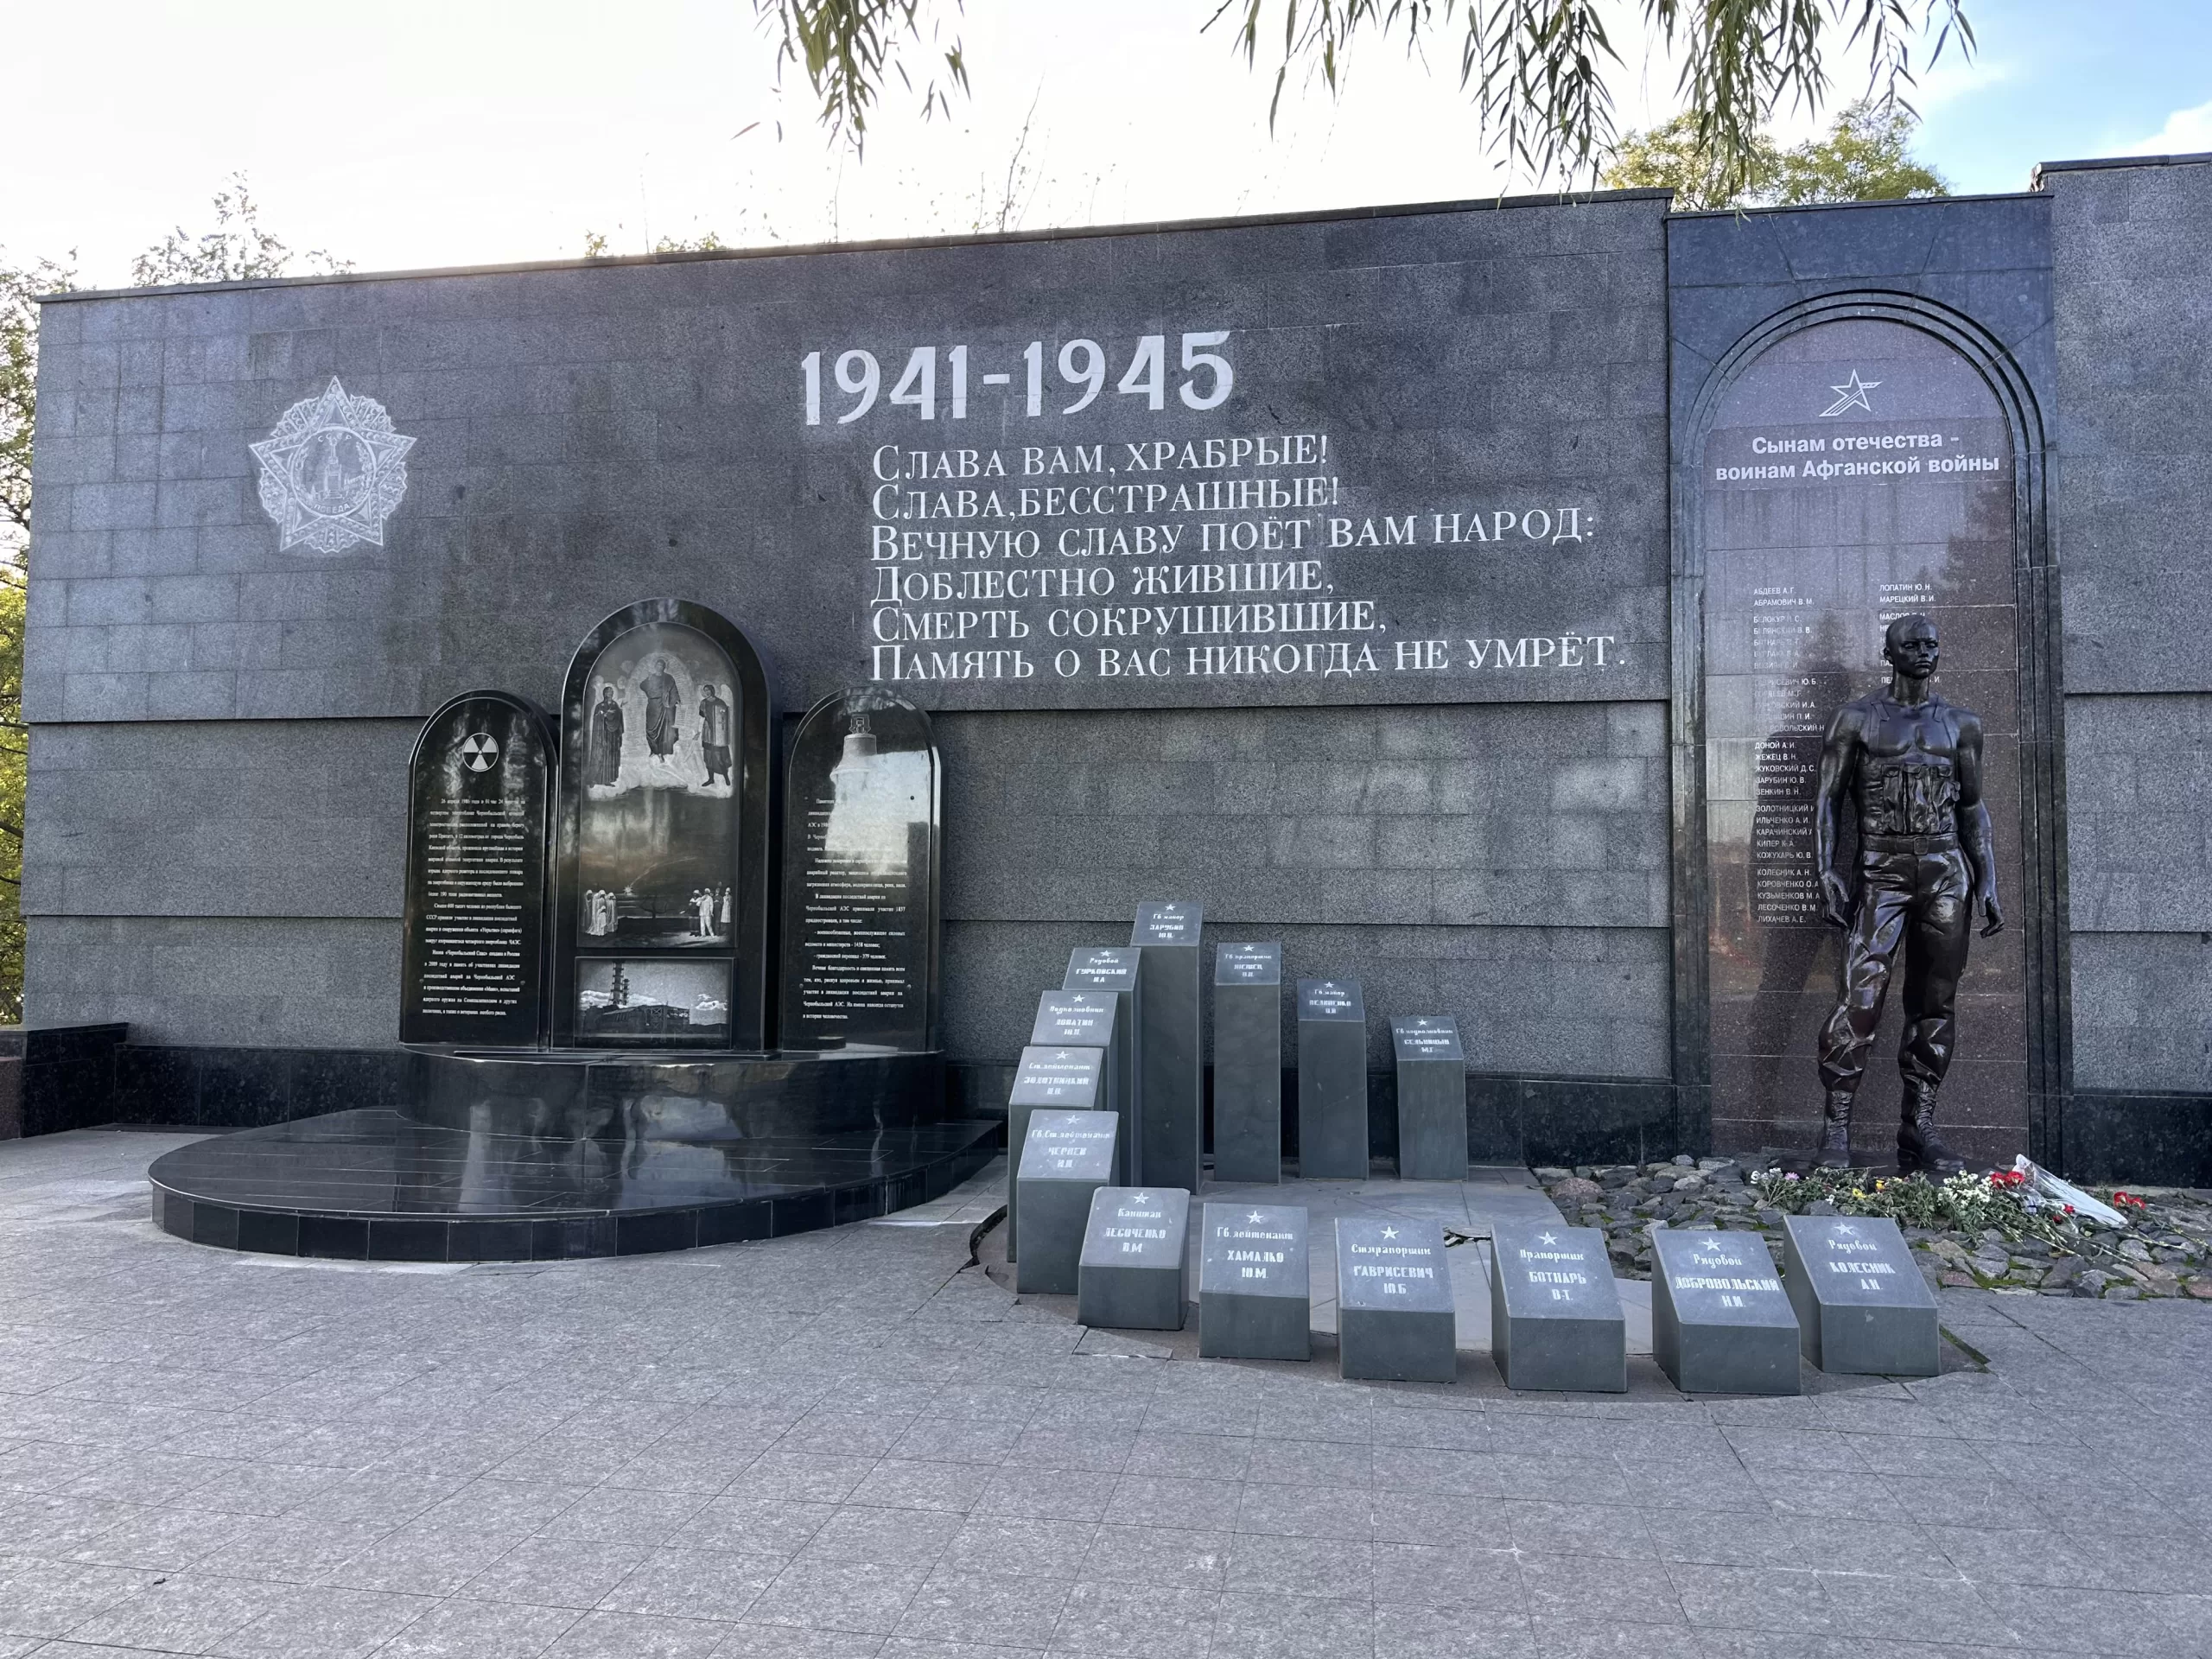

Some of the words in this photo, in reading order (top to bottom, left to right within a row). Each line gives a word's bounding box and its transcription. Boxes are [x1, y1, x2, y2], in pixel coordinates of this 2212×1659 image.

[800, 330, 1235, 426] 1941-1945
[1751, 437, 1826, 454] Сынам
[1832, 434, 1943, 450] отечества
[1715, 465, 1796, 480] воинам
[1802, 457, 1921, 481] Афганской
[1928, 454, 1999, 474] войны
[1117, 1208, 1161, 1218] Капитан
[1103, 1227, 1166, 1239] ЛЕСОЧЕНКО
[1226, 1249, 1285, 1263] ХАМАЛКО
[1519, 1249, 1585, 1263] Прапорщик
[1353, 1265, 1433, 1279] ГАВРИСЕВИЧ
[1828, 1262, 1896, 1274] КОЛЕСНИК
[1529, 1271, 1587, 1285] БОТНАРЬ
[1675, 1275, 1780, 1291] ДОБРОВОЛЬСКИЙ
